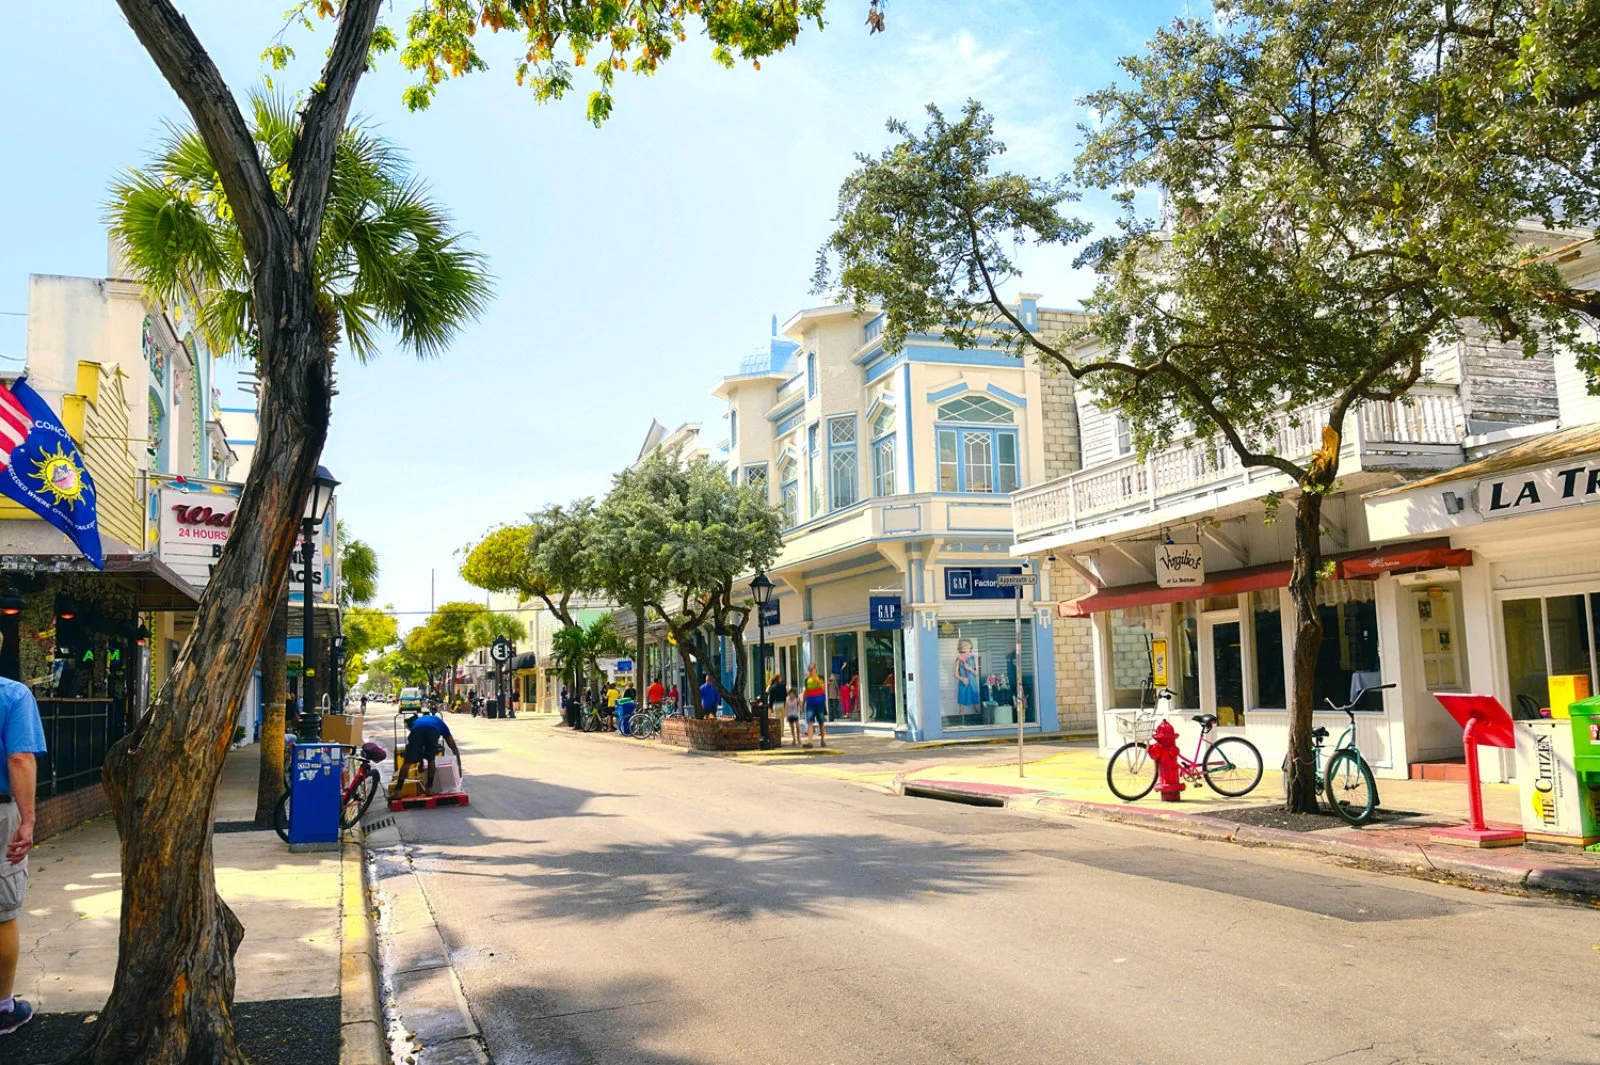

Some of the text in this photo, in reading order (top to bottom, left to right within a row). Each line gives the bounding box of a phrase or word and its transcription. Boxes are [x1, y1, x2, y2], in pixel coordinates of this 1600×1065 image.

[35, 420, 71, 441] CONCH
[27, 490, 51, 508] WHERE
[1489, 480, 1541, 511] LA
[178, 528, 228, 541] 24 HOURS
[952, 577, 968, 589] GAP
[877, 604, 895, 619] GAP
[1534, 734, 1553, 793] CITIZEN
[1542, 798, 1556, 827] THE
